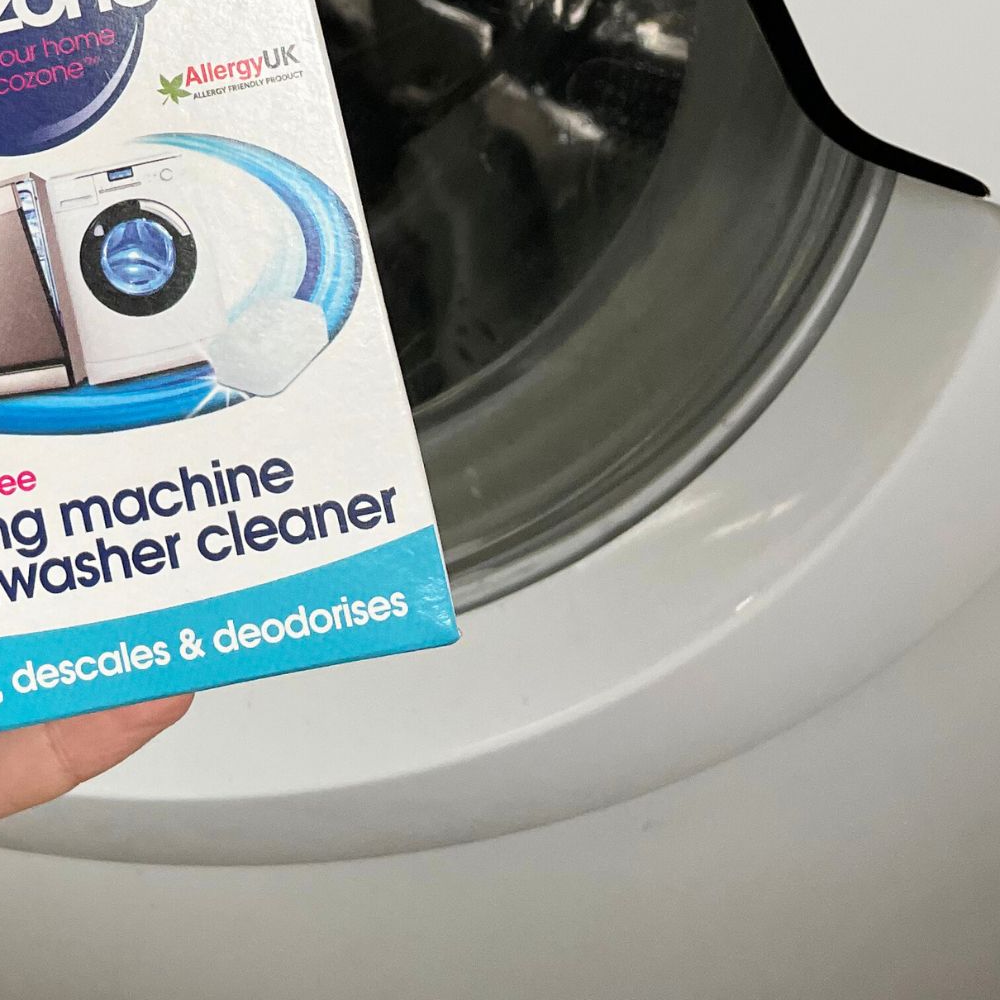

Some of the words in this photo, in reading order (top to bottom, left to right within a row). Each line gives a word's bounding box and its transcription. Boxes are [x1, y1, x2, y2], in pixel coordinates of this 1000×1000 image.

[42, 27, 117, 56] home
[193, 86, 227, 100] ALLERGY
[228, 79, 264, 94] FRIENDLY
[266, 70, 304, 86] PRODUCT
[60, 457, 292, 536] machine
[197, 487, 398, 560] cleaner
[10, 641, 170, 692] descales
[179, 628, 206, 661] &
[212, 593, 408, 652] deodorises
